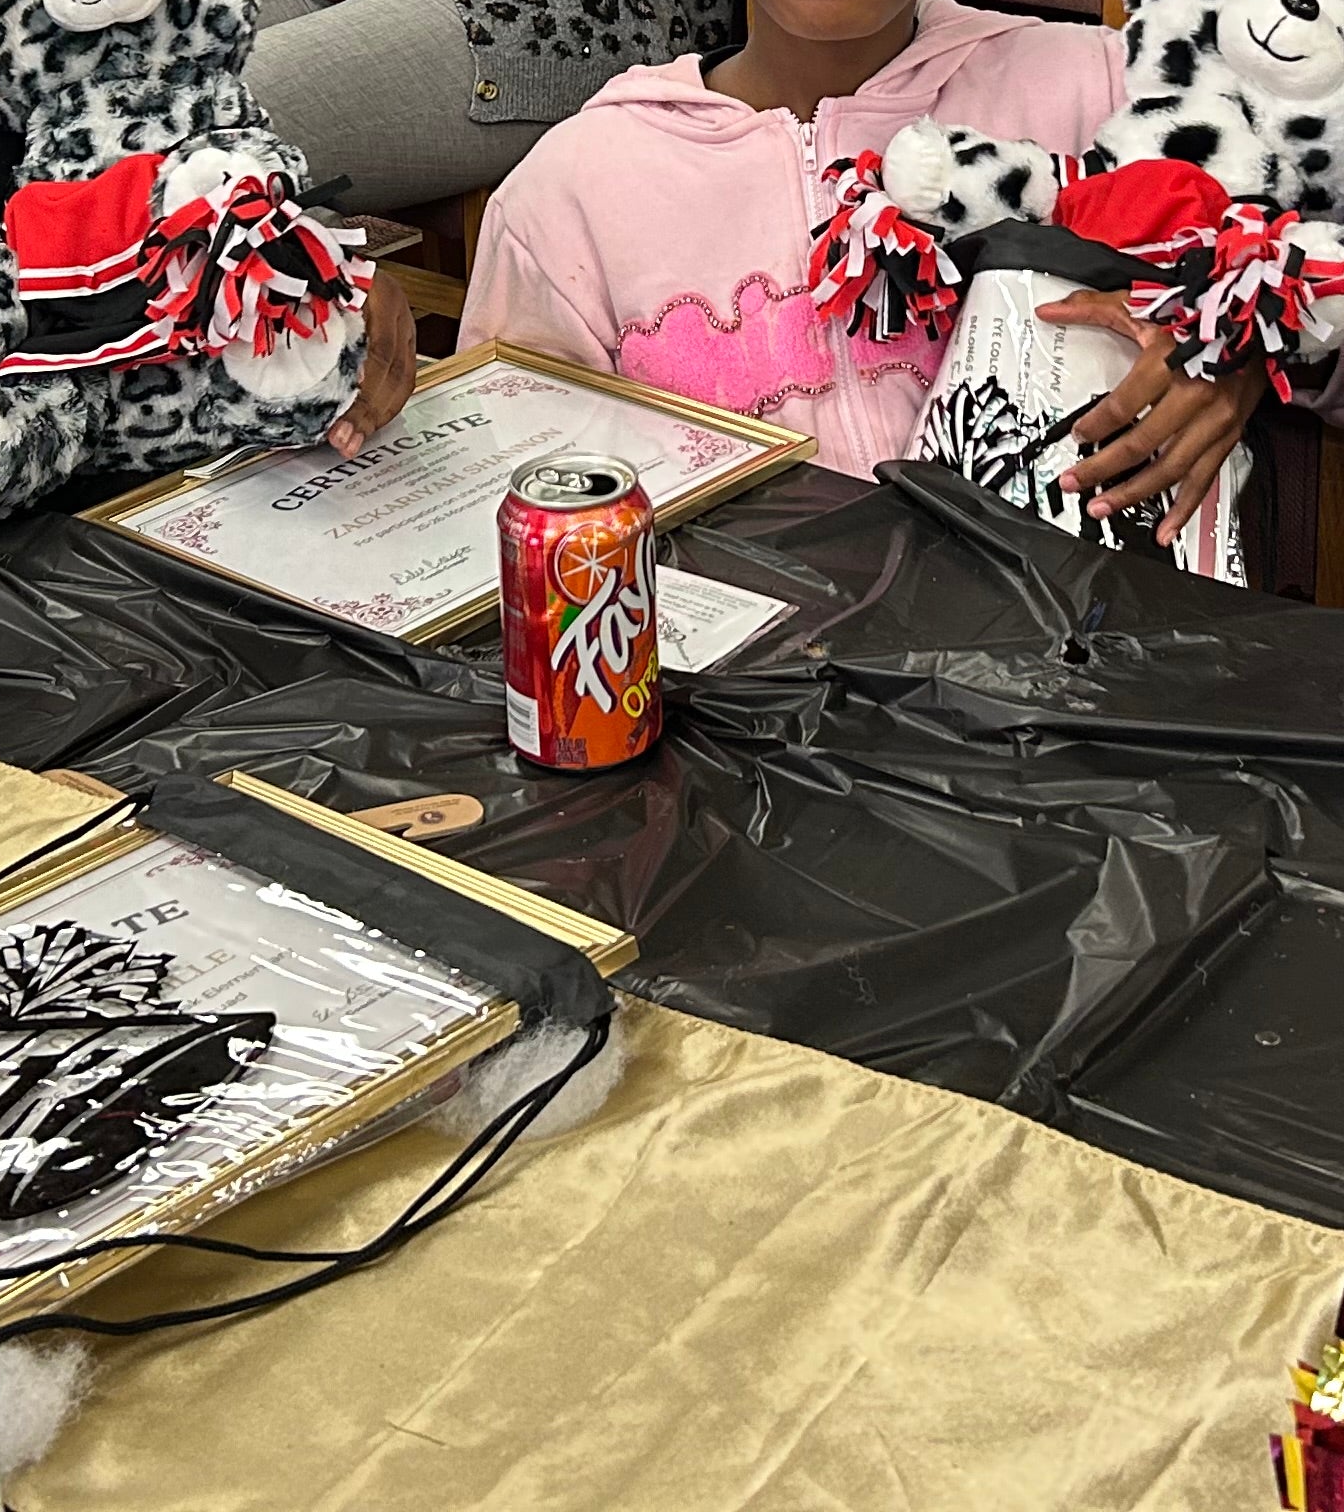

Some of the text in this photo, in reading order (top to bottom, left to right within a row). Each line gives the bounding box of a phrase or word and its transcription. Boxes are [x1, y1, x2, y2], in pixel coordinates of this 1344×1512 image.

[988, 342, 1002, 378] COLO
[271, 412, 492, 512] CERTIFICATE
[365, 439, 457, 483] PARTICIPATION
[324, 426, 563, 539] ZACKARIYAH SHANNON
[356, 486, 379, 499] The
[353, 535, 374, 548] For
